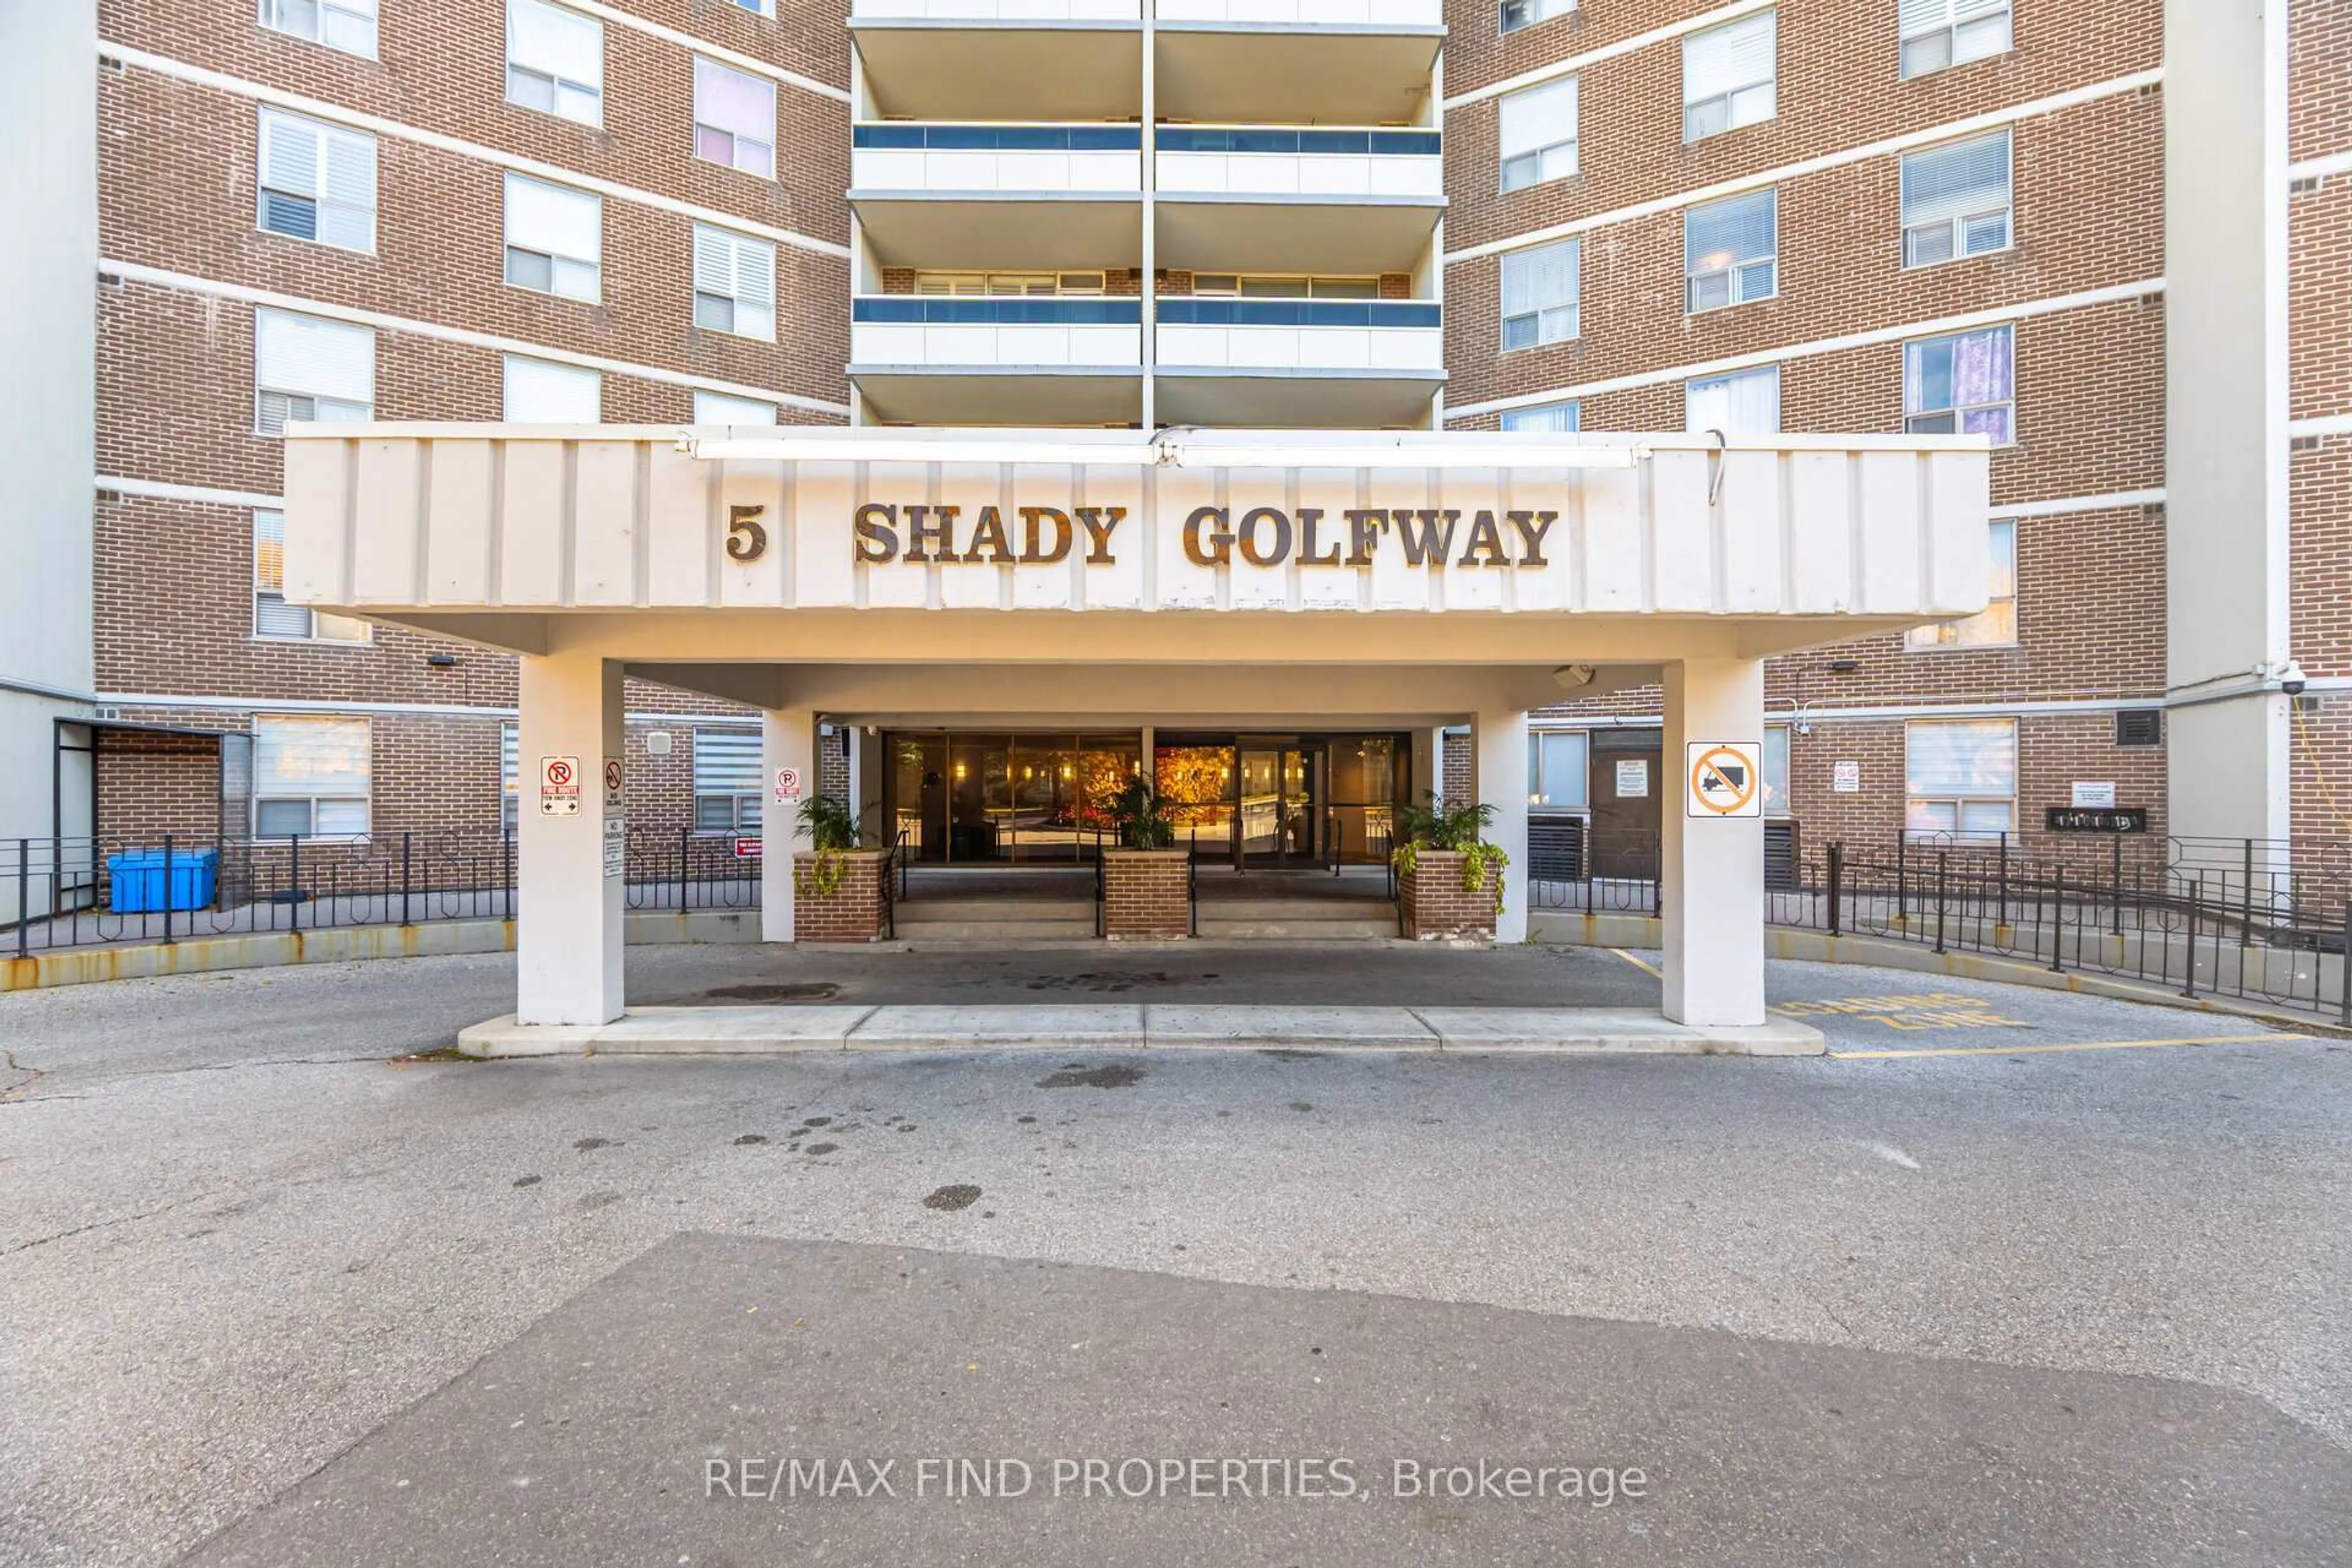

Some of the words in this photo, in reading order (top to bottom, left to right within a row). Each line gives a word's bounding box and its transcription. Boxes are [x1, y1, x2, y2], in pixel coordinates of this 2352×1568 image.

[726, 503, 767, 563] 5
[854, 502, 1127, 565] SHADY
[1182, 505, 1559, 569] GOLFWAY
